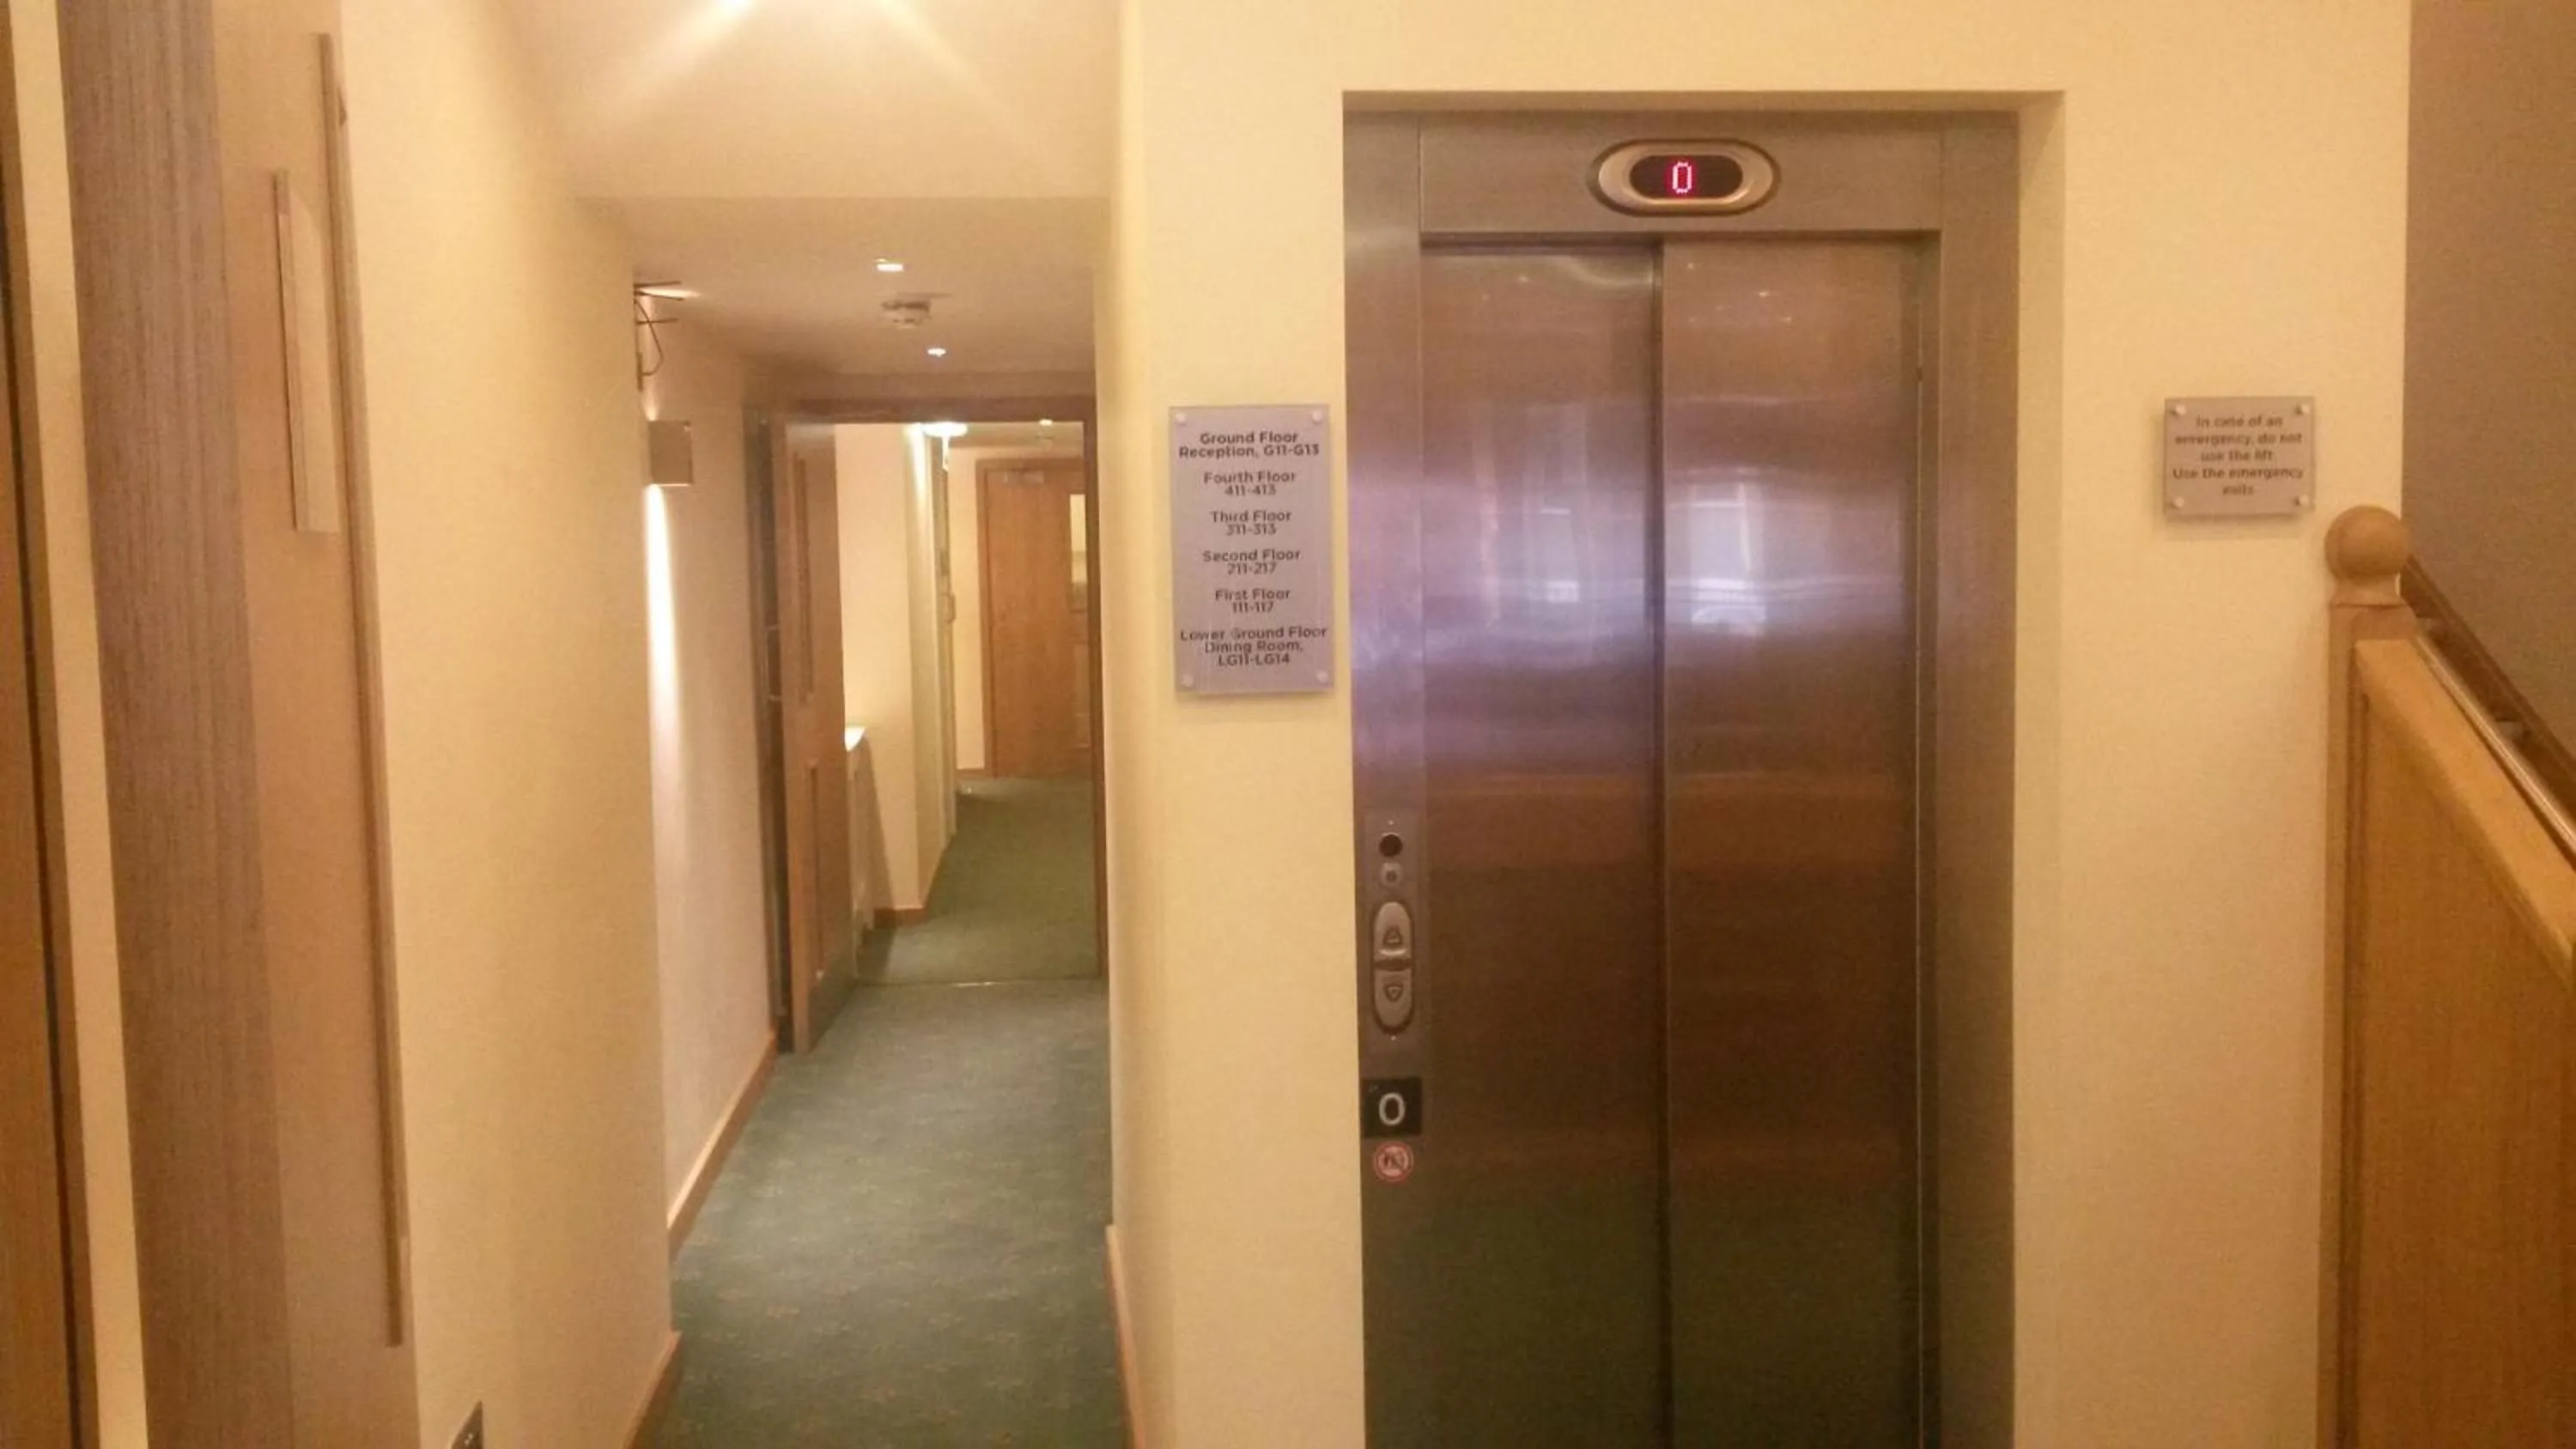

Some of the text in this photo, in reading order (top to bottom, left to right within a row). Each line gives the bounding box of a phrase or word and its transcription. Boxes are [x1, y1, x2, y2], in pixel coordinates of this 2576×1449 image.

[1673, 161, 1692, 193] 0
[1200, 430, 1299, 445] Ground Floor
[1179, 444, 1320, 459] Reception, G11-G13
[1204, 470, 1296, 483] Fourth Floor
[1224, 484, 1277, 495] 411-413
[1211, 510, 1291, 523] Third Floor
[1226, 523, 1277, 536] 311-313
[1203, 549, 1301, 562] Second Floor
[1227, 562, 1277, 574] 211-217
[1215, 588, 1291, 601] First Floor
[1232, 602, 1274, 613] 111-117
[1181, 626, 1327, 640] Lower Ground Floor
[1205, 640, 1304, 653] Dining Room,
[1218, 653, 1291, 666] LG11-LG14
